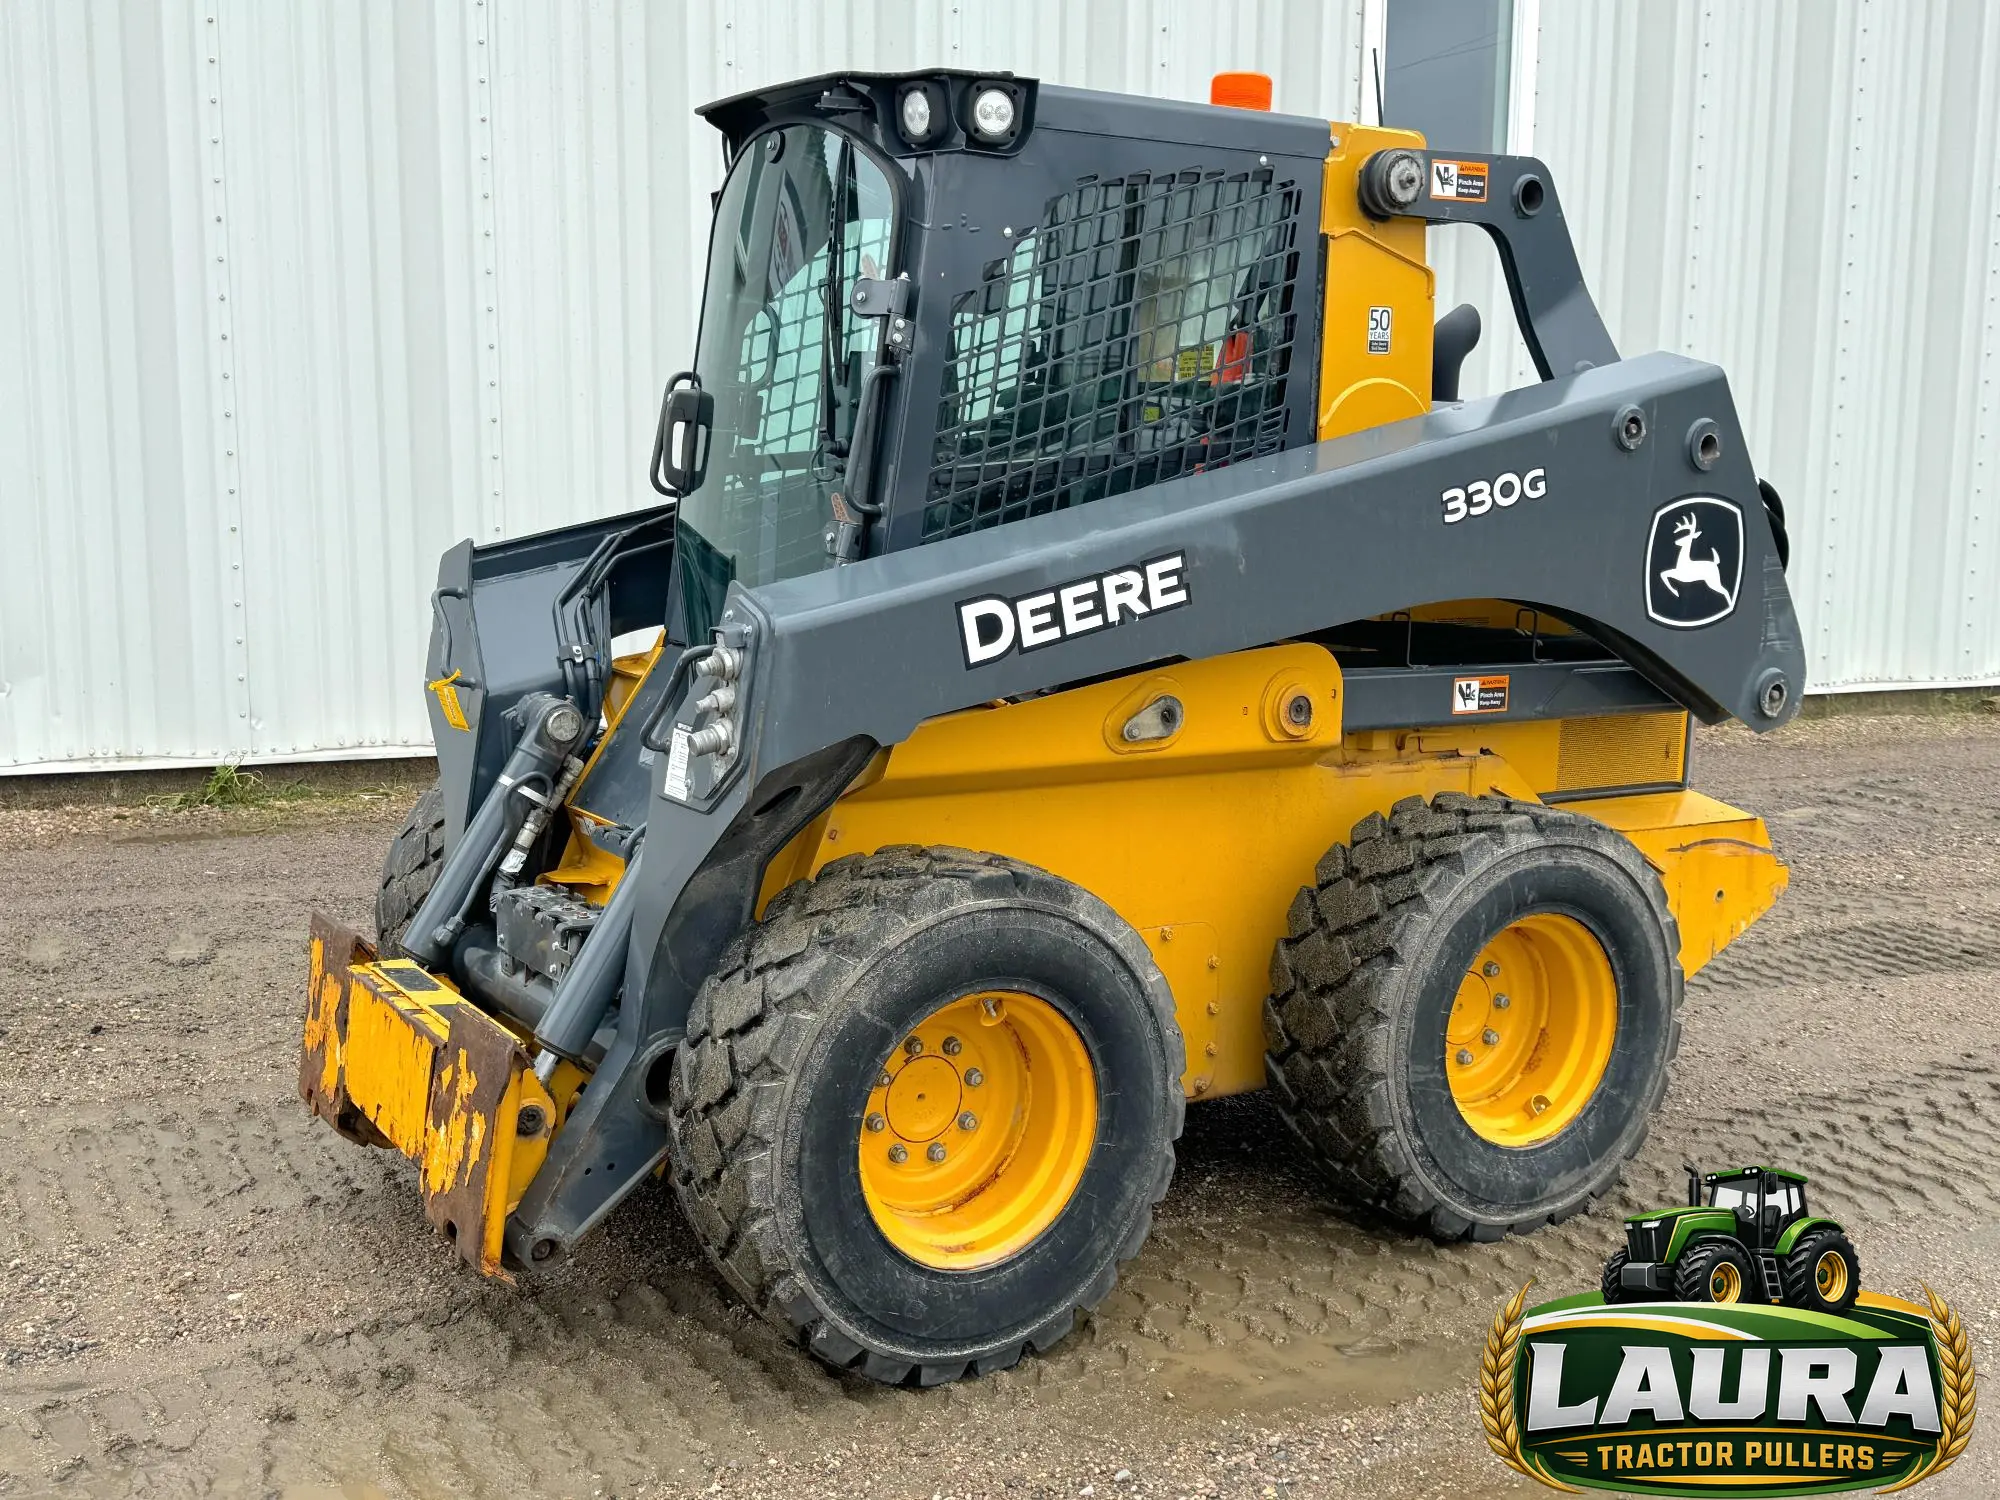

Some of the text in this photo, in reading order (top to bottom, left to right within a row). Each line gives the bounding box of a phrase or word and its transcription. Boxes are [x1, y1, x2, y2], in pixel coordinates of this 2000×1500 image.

[1370, 309, 1390, 331] 50
[1370, 331, 1389, 340] YEARS
[1442, 467, 1547, 523] 330G
[958, 553, 1190, 667] DEERE
